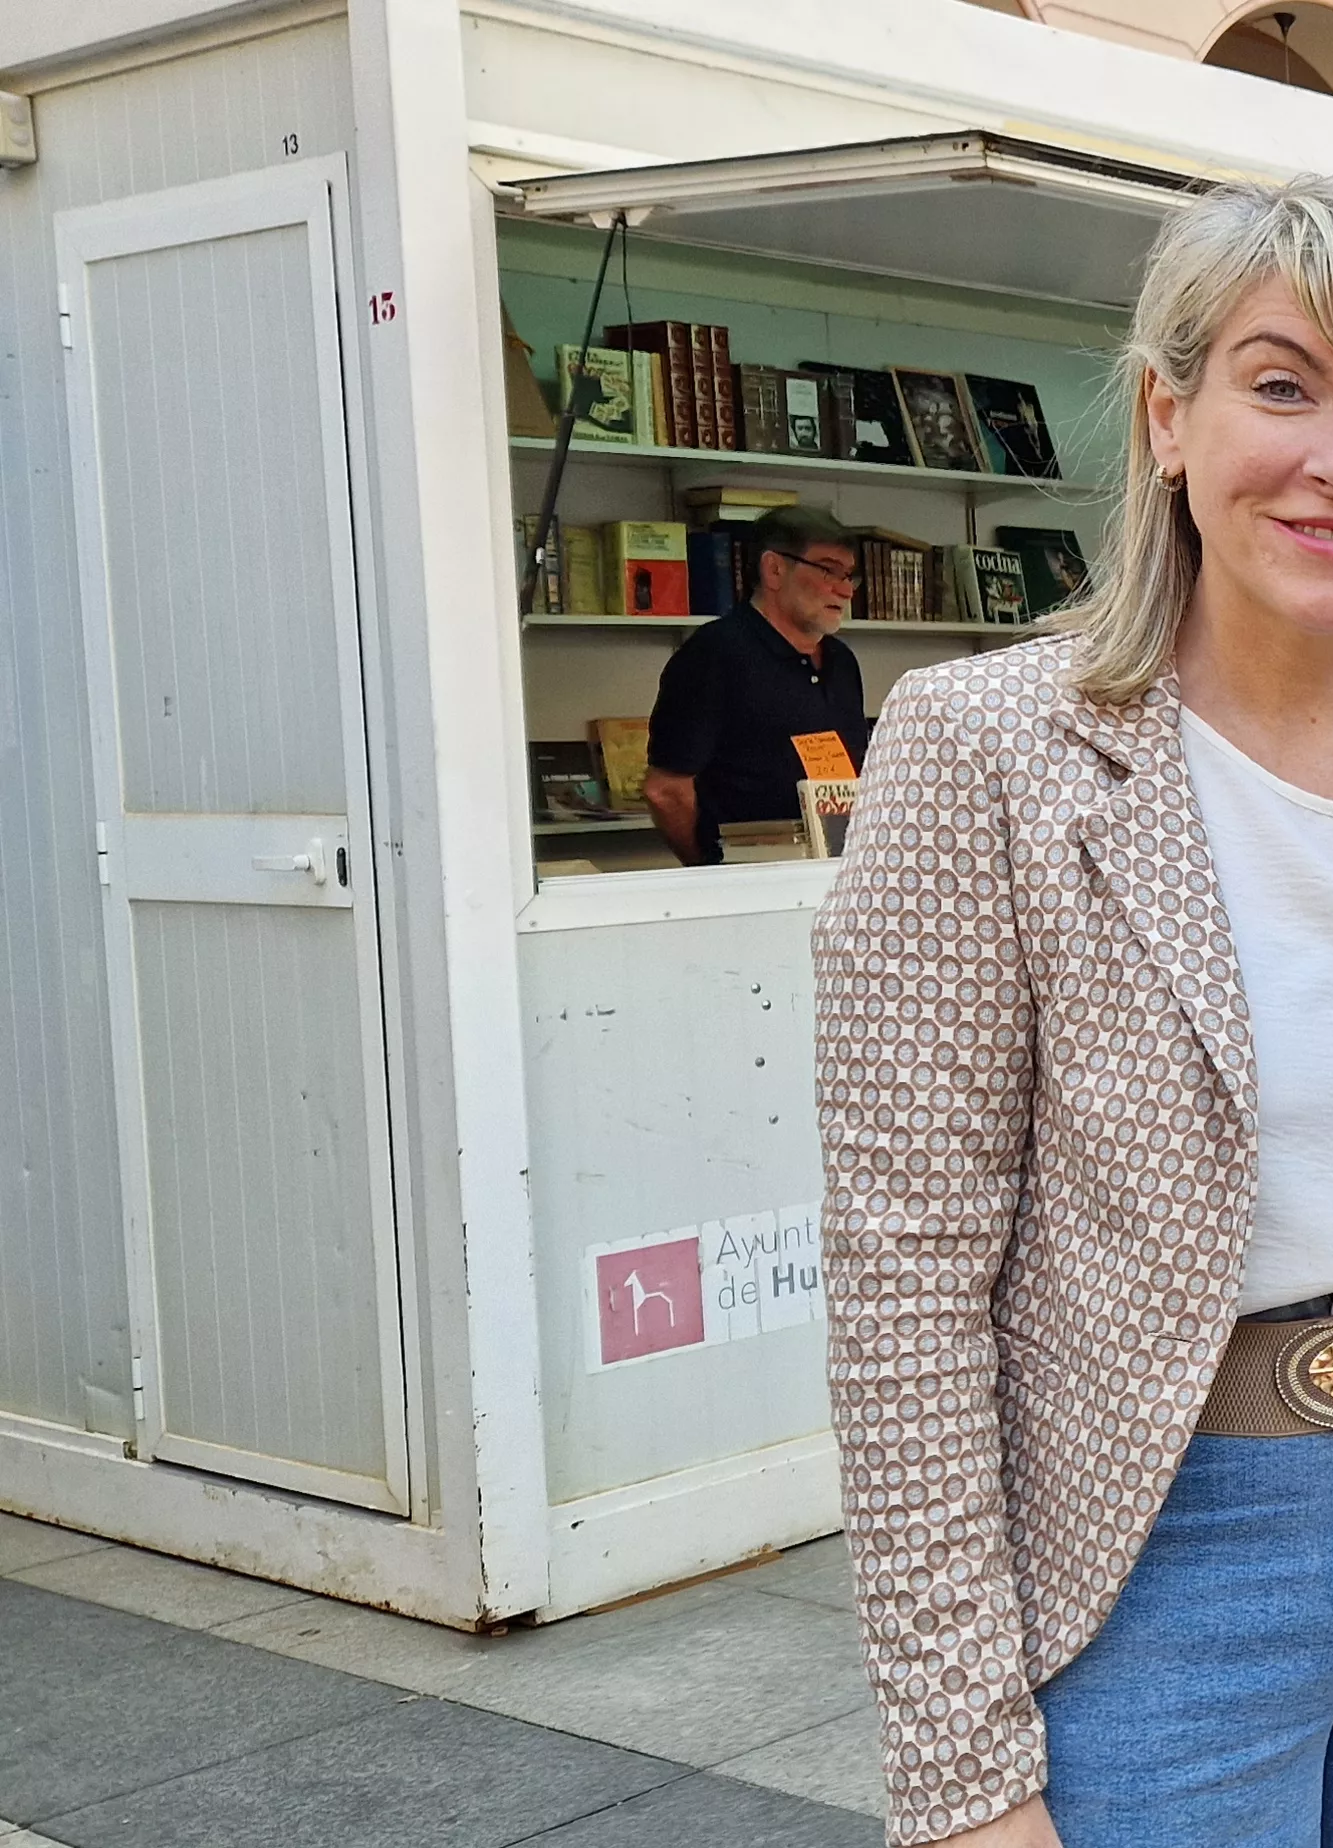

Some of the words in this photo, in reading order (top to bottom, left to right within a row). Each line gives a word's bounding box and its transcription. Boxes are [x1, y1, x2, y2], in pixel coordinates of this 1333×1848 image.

[282, 133, 299, 156] 13
[975, 550, 1021, 575] cocina
[715, 1216, 814, 1269] Ayunt
[718, 1276, 758, 1310] de
[772, 1262, 819, 1298] Hu
